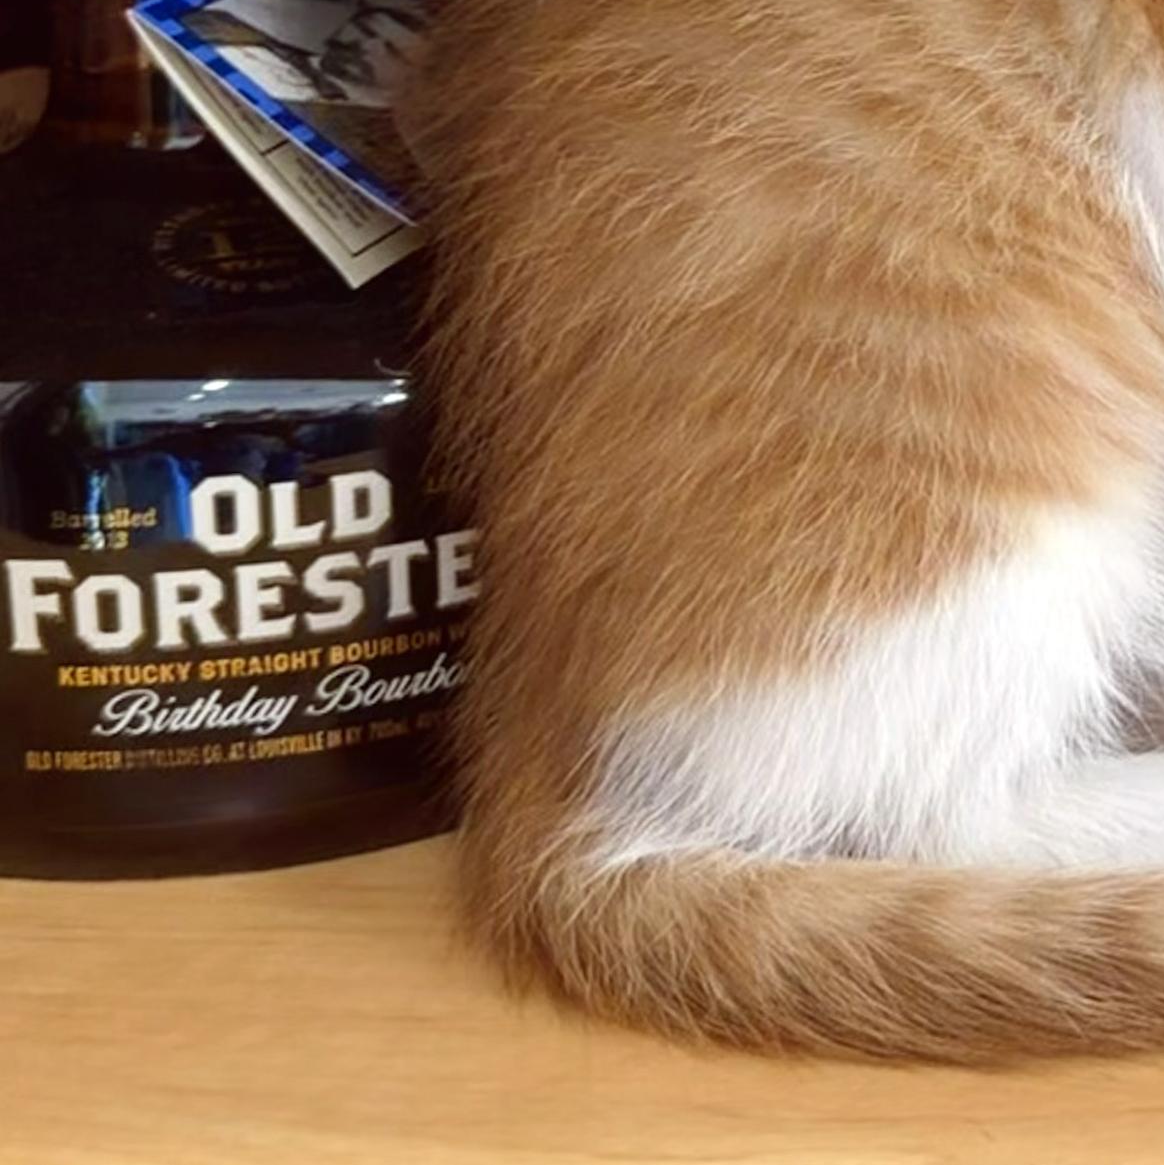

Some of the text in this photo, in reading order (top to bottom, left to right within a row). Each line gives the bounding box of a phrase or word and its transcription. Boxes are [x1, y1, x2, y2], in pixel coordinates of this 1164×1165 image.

[189, 468, 393, 555] OLD
[4, 528, 483, 653] FORESTE
[58, 661, 192, 688] KENTUCKY
[200, 650, 322, 681] STRAIGHT
[329, 630, 442, 666] BOURBON
[94, 652, 466, 737] Birthday Bourbo
